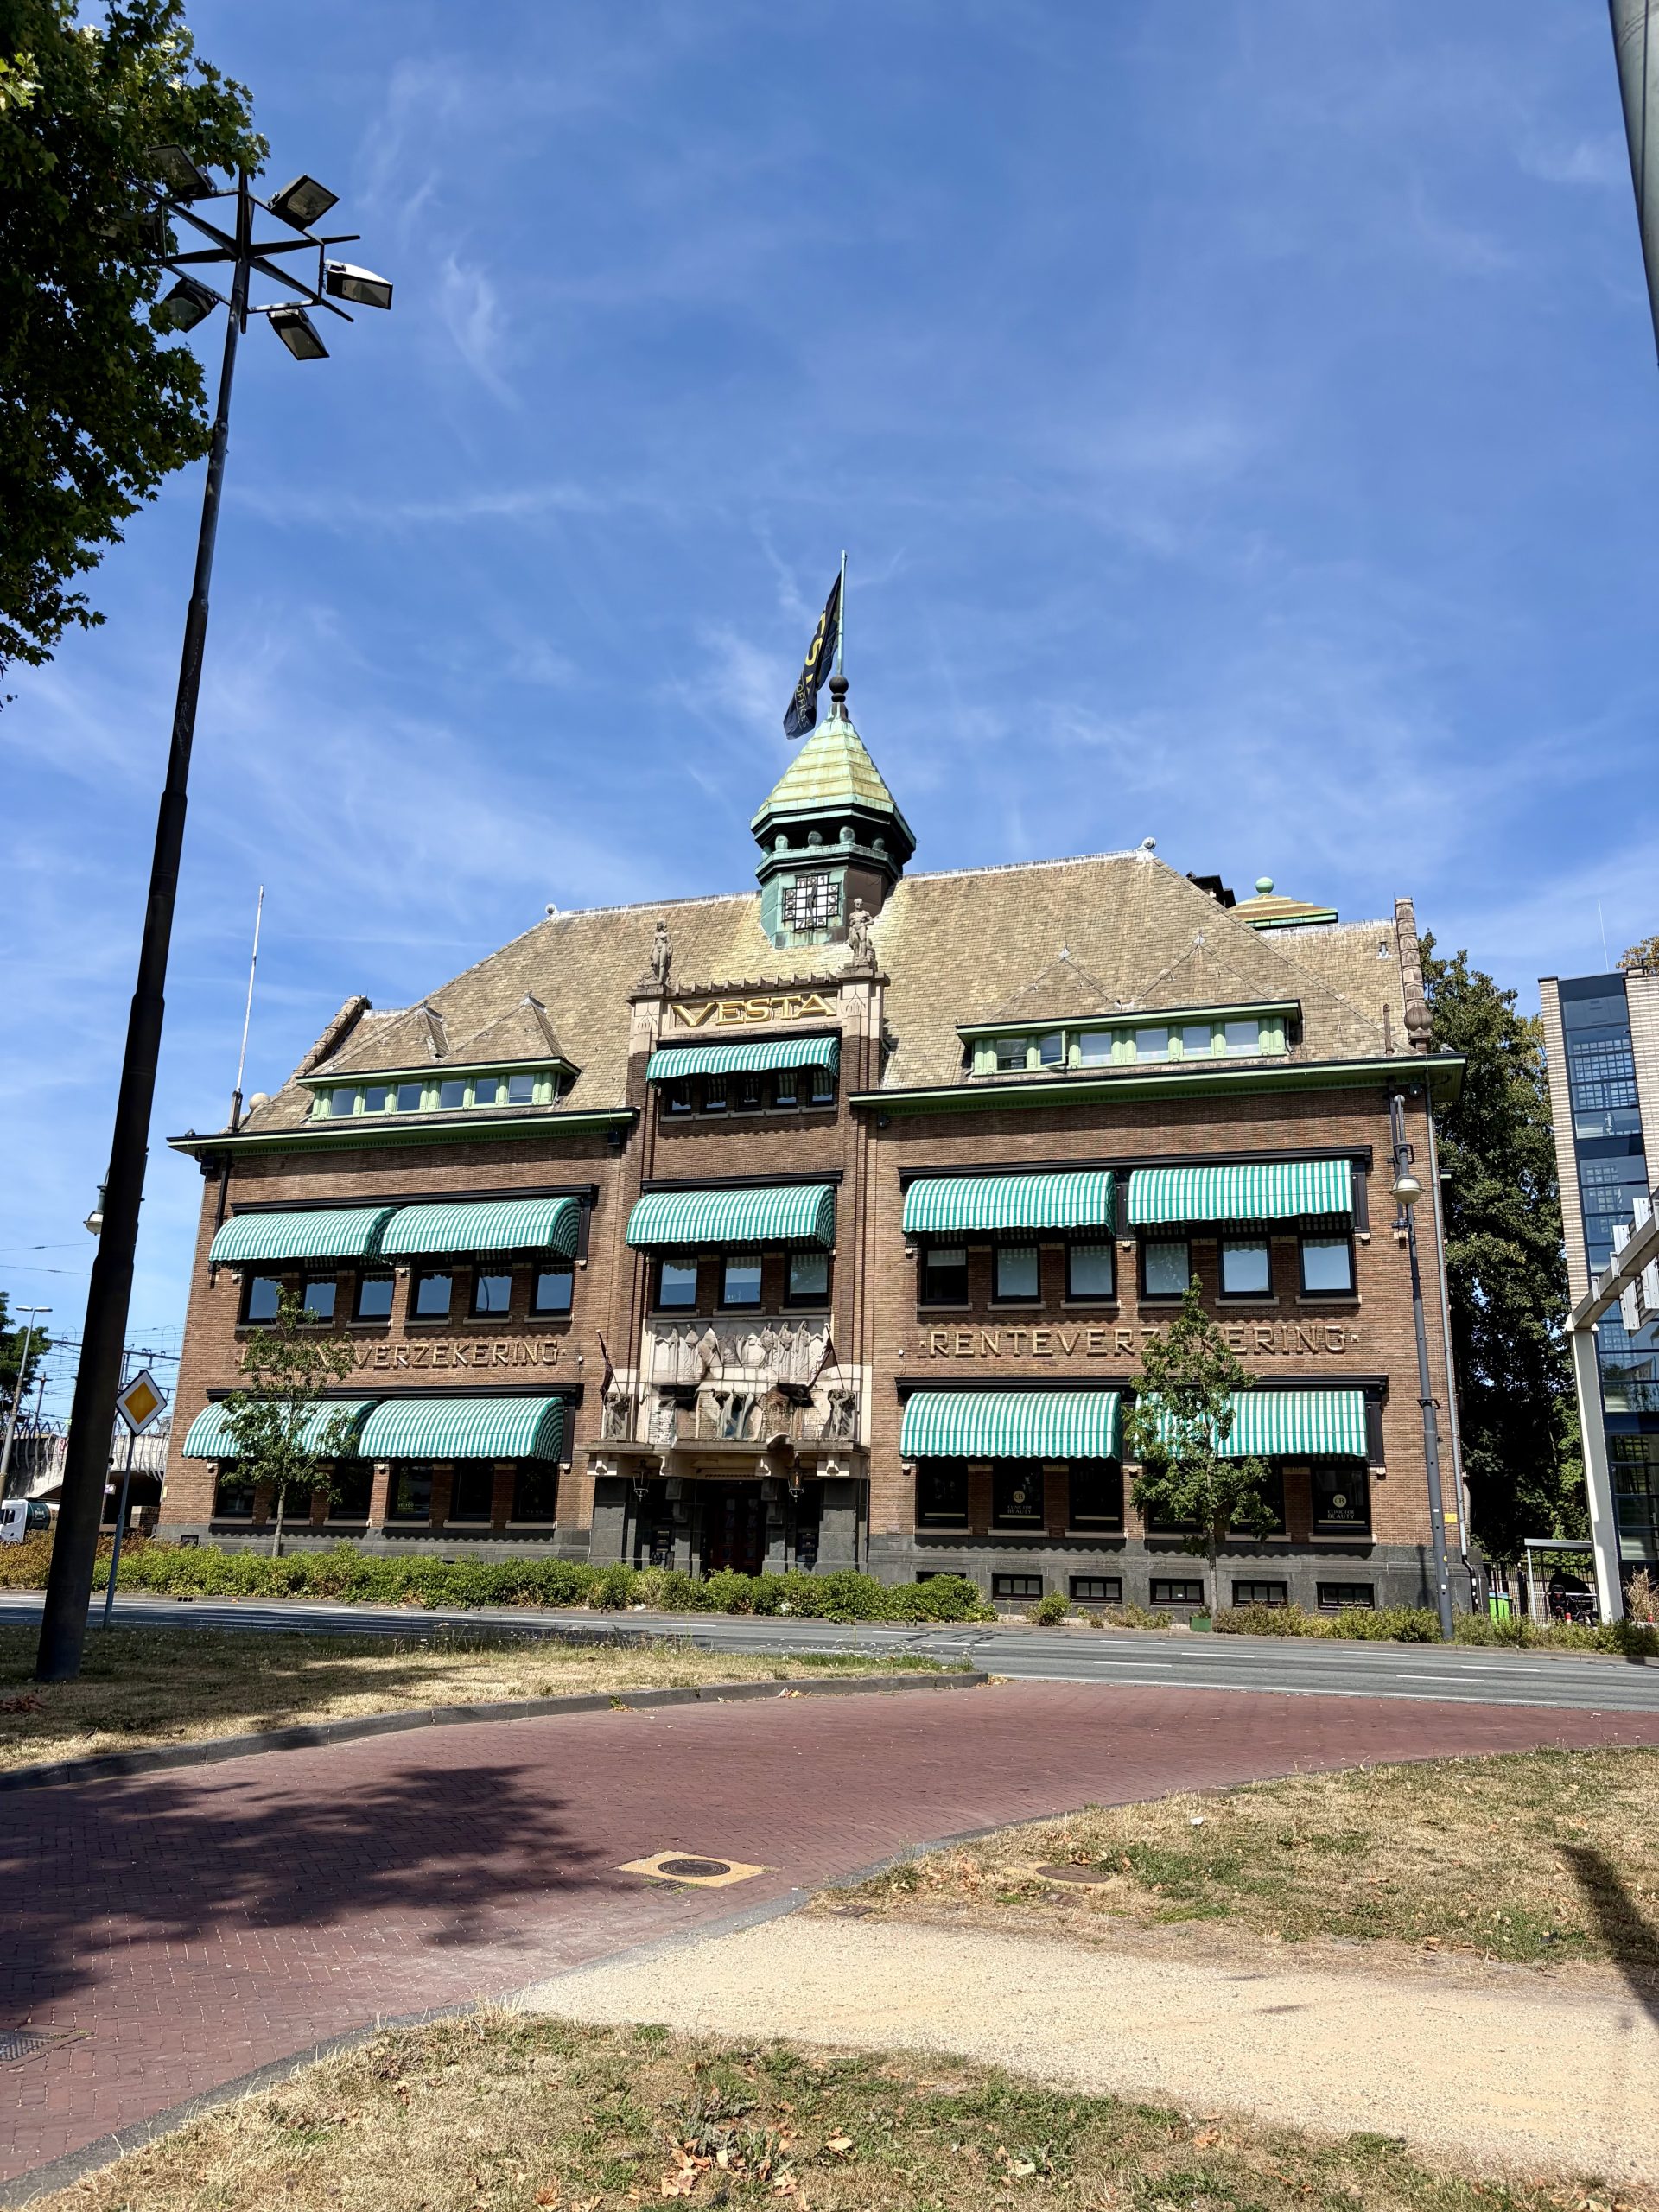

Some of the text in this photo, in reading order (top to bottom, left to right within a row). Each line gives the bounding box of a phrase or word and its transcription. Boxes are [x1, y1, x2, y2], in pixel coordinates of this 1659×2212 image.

[798, 877, 807, 887] 11
[786, 890, 795, 899] 10
[786, 899, 795, 909] 9
[829, 895, 837, 905] 3
[786, 910, 794, 919] 8
[829, 906, 837, 915] 4
[797, 920, 804, 929] 7
[817, 918, 825, 926] 5
[672, 994, 836, 1027] VESTA
[930, 1325, 1345, 1357] RENTEVERZKERING
[241, 1340, 558, 1370] LVERZEKERING
